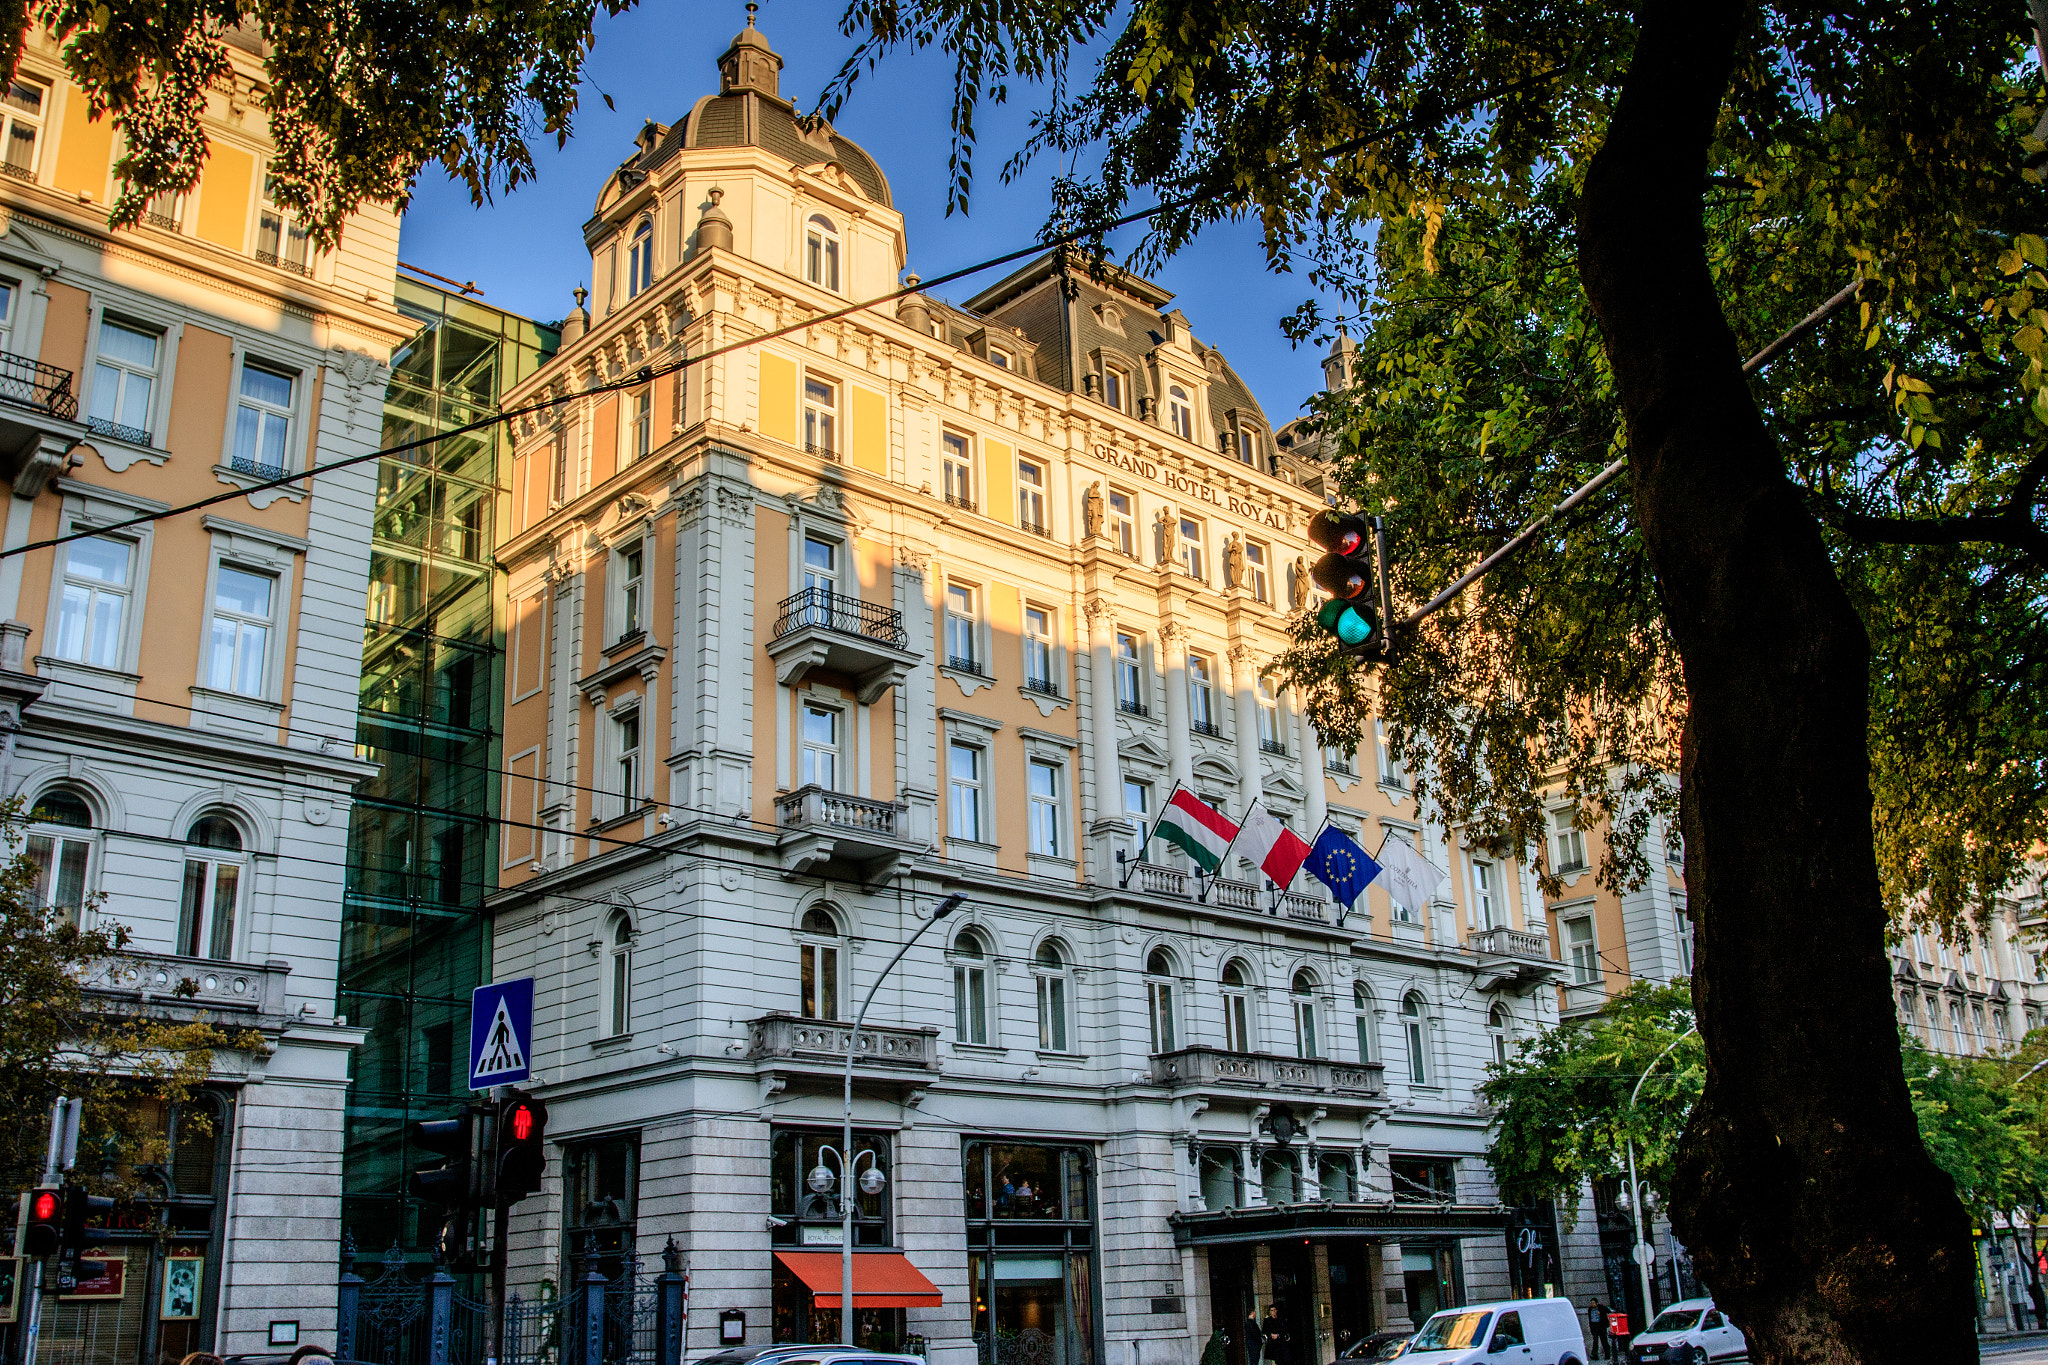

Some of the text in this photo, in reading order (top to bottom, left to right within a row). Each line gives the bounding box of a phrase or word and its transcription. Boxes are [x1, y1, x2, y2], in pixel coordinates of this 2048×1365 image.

[1094, 444, 1285, 531] GRAND HOTEL ROYAL
[1389, 864, 1418, 890] CORINTHIA
